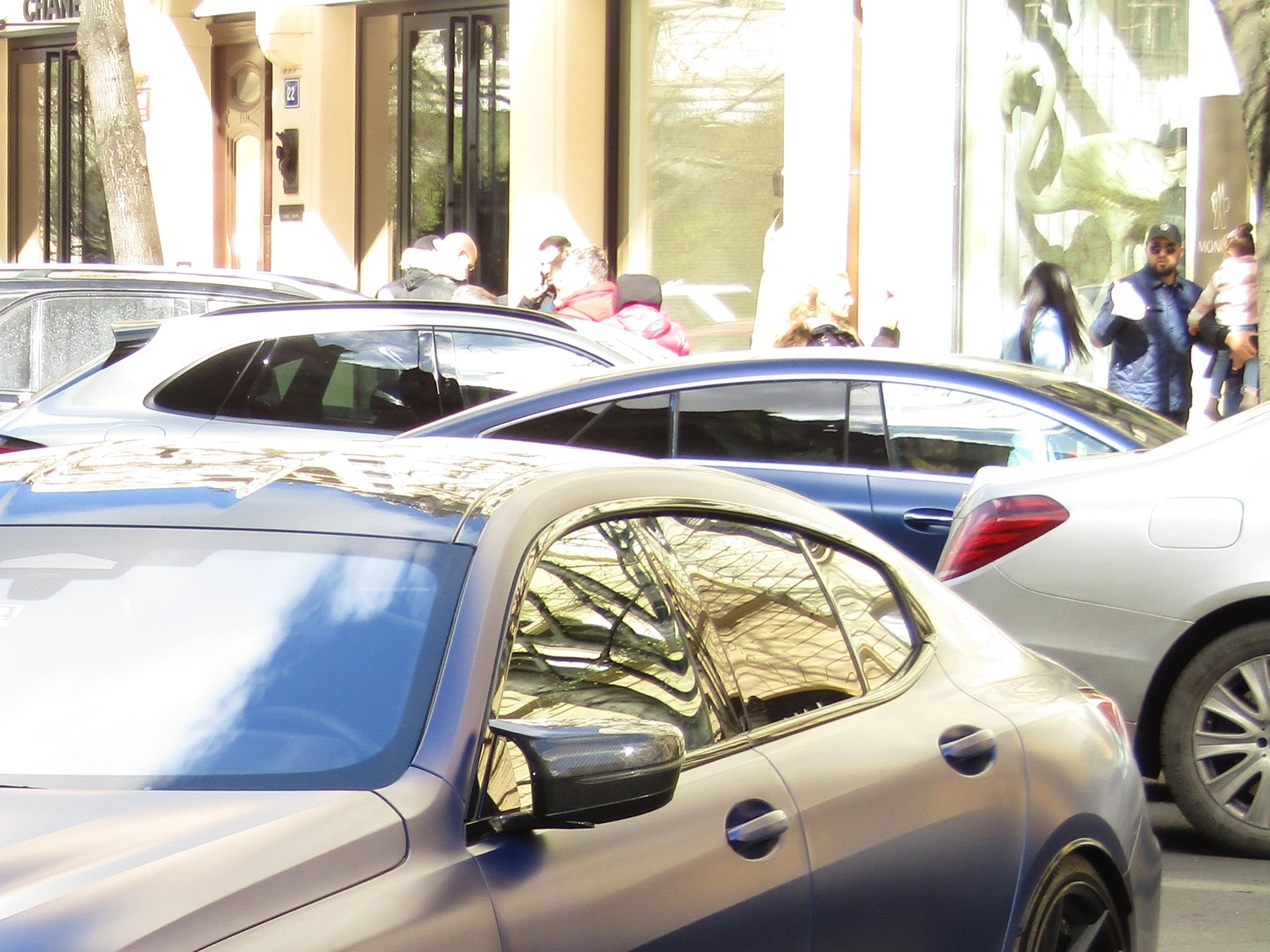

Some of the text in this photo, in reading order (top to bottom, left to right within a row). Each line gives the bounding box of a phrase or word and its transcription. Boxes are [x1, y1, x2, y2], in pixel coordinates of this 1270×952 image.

[23, 0, 81, 22] CHANE
[286, 85, 296, 101] 22
[1197, 240, 1221, 253] MON
